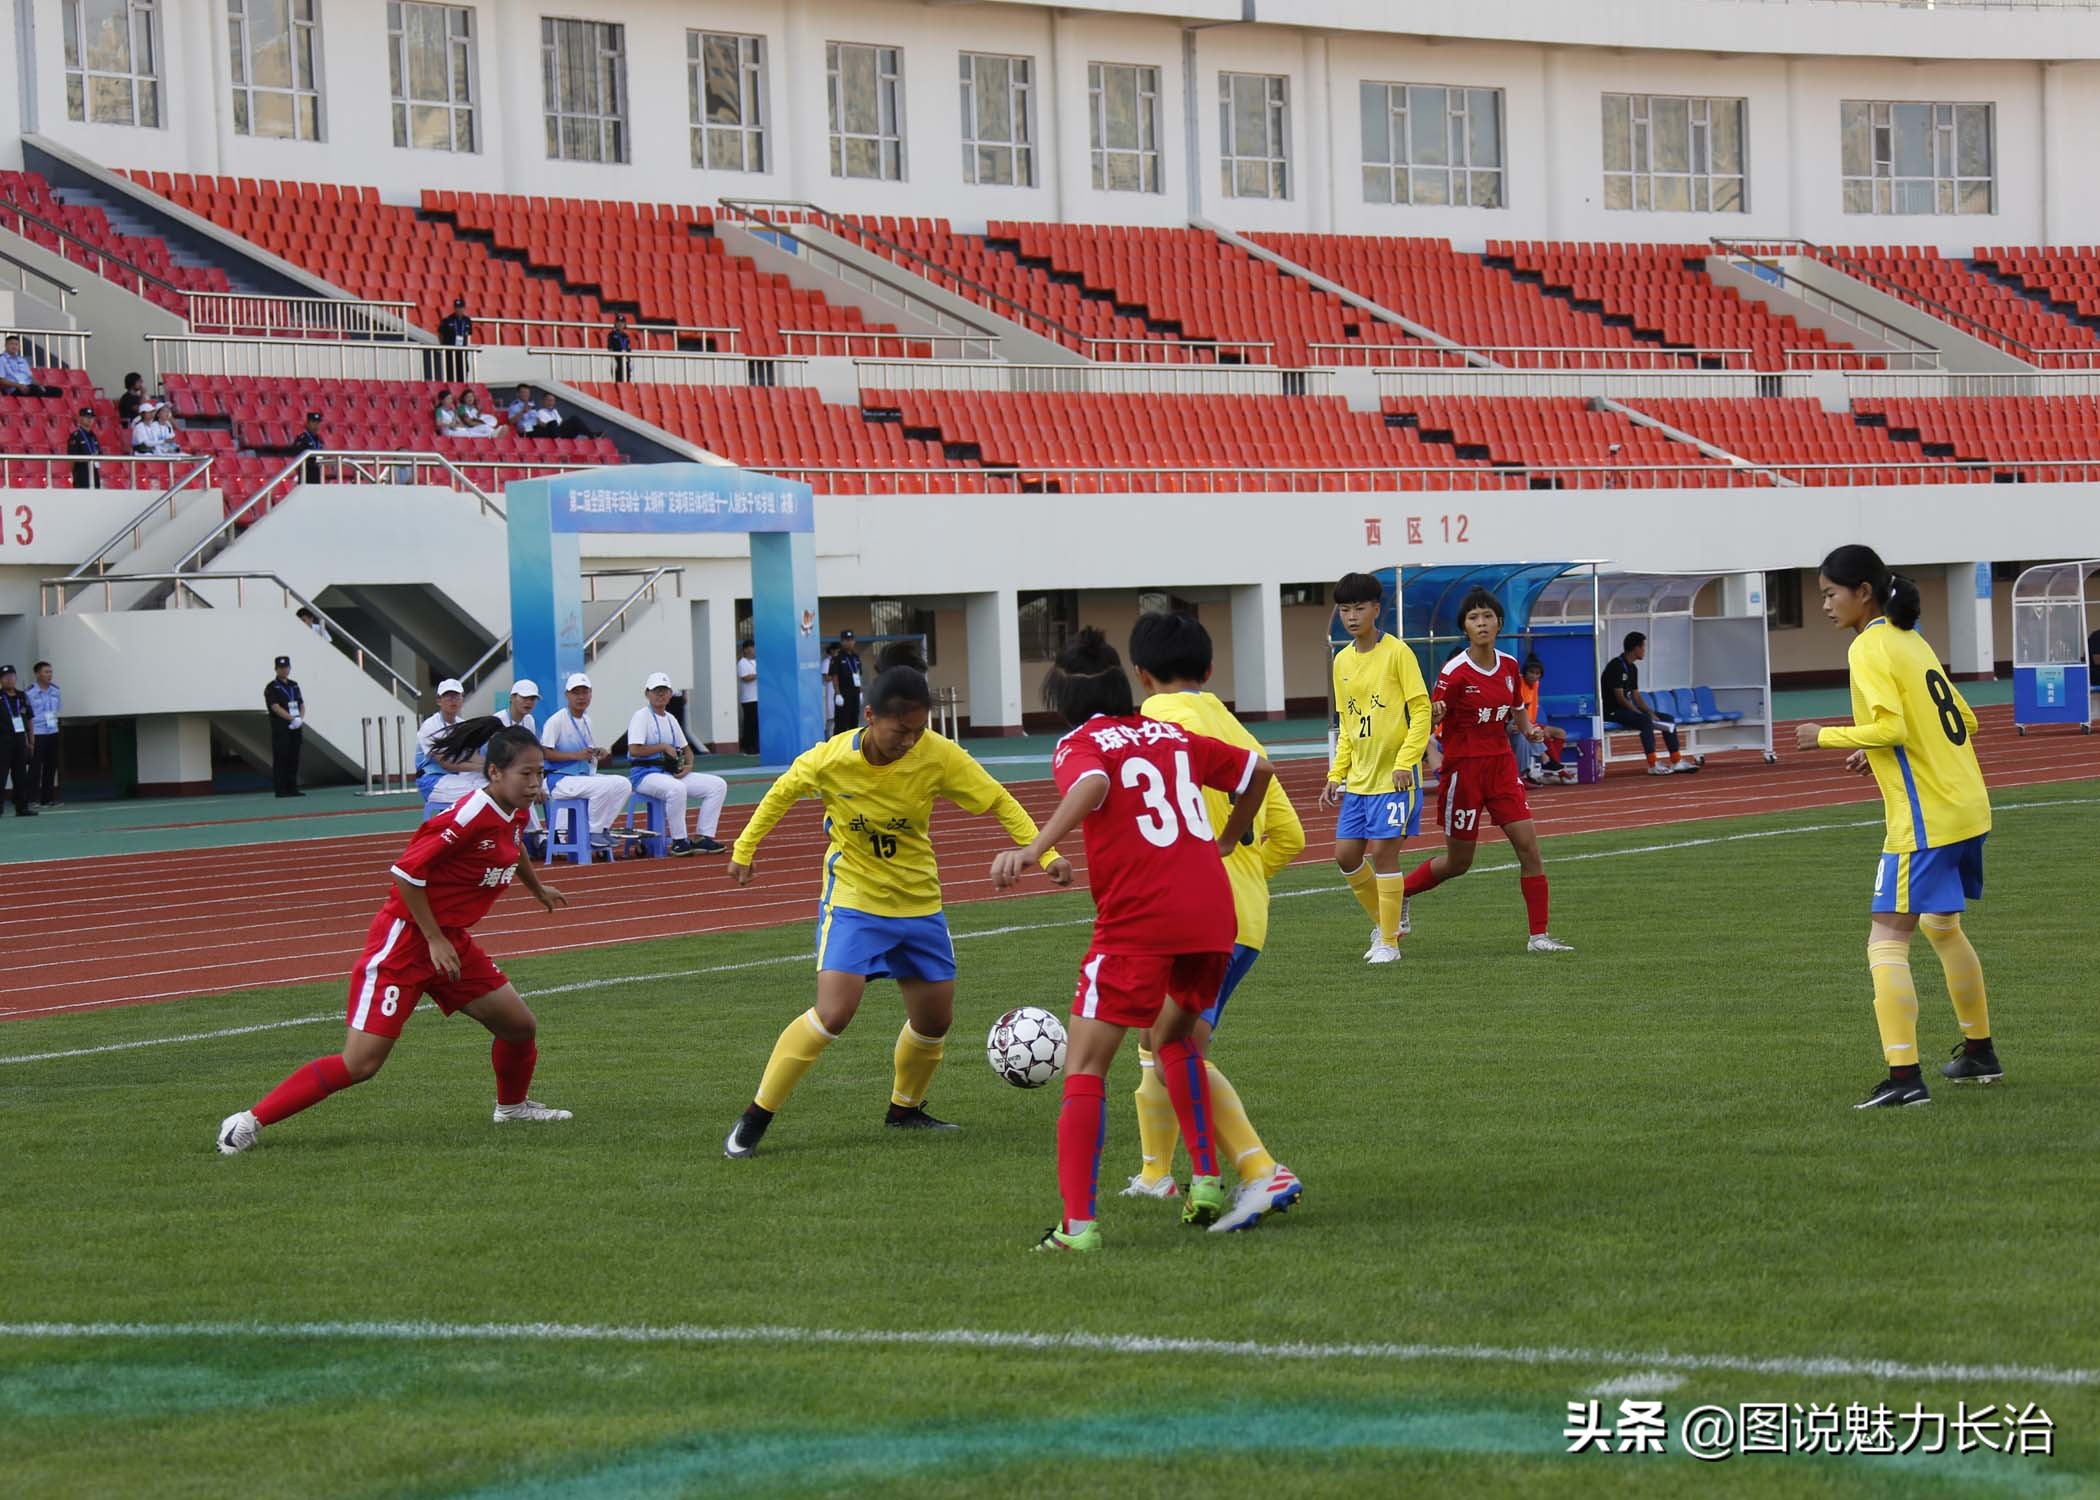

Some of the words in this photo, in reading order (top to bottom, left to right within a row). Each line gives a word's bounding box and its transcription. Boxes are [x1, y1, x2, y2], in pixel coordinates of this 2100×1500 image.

[1364, 517, 1423, 545] 西区
[1441, 514, 1469, 543] 12
[1348, 694, 1386, 716] 武汉
[1477, 705, 1510, 724] 海南
[1925, 669, 1967, 746] 8
[1359, 715, 1372, 738] 21
[1120, 750, 1214, 848] 36
[848, 813, 912, 835] 武汉
[1386, 801, 1406, 825] 21
[1454, 808, 1477, 831] 37
[869, 834, 897, 859] 15
[381, 985, 400, 1017] 8
